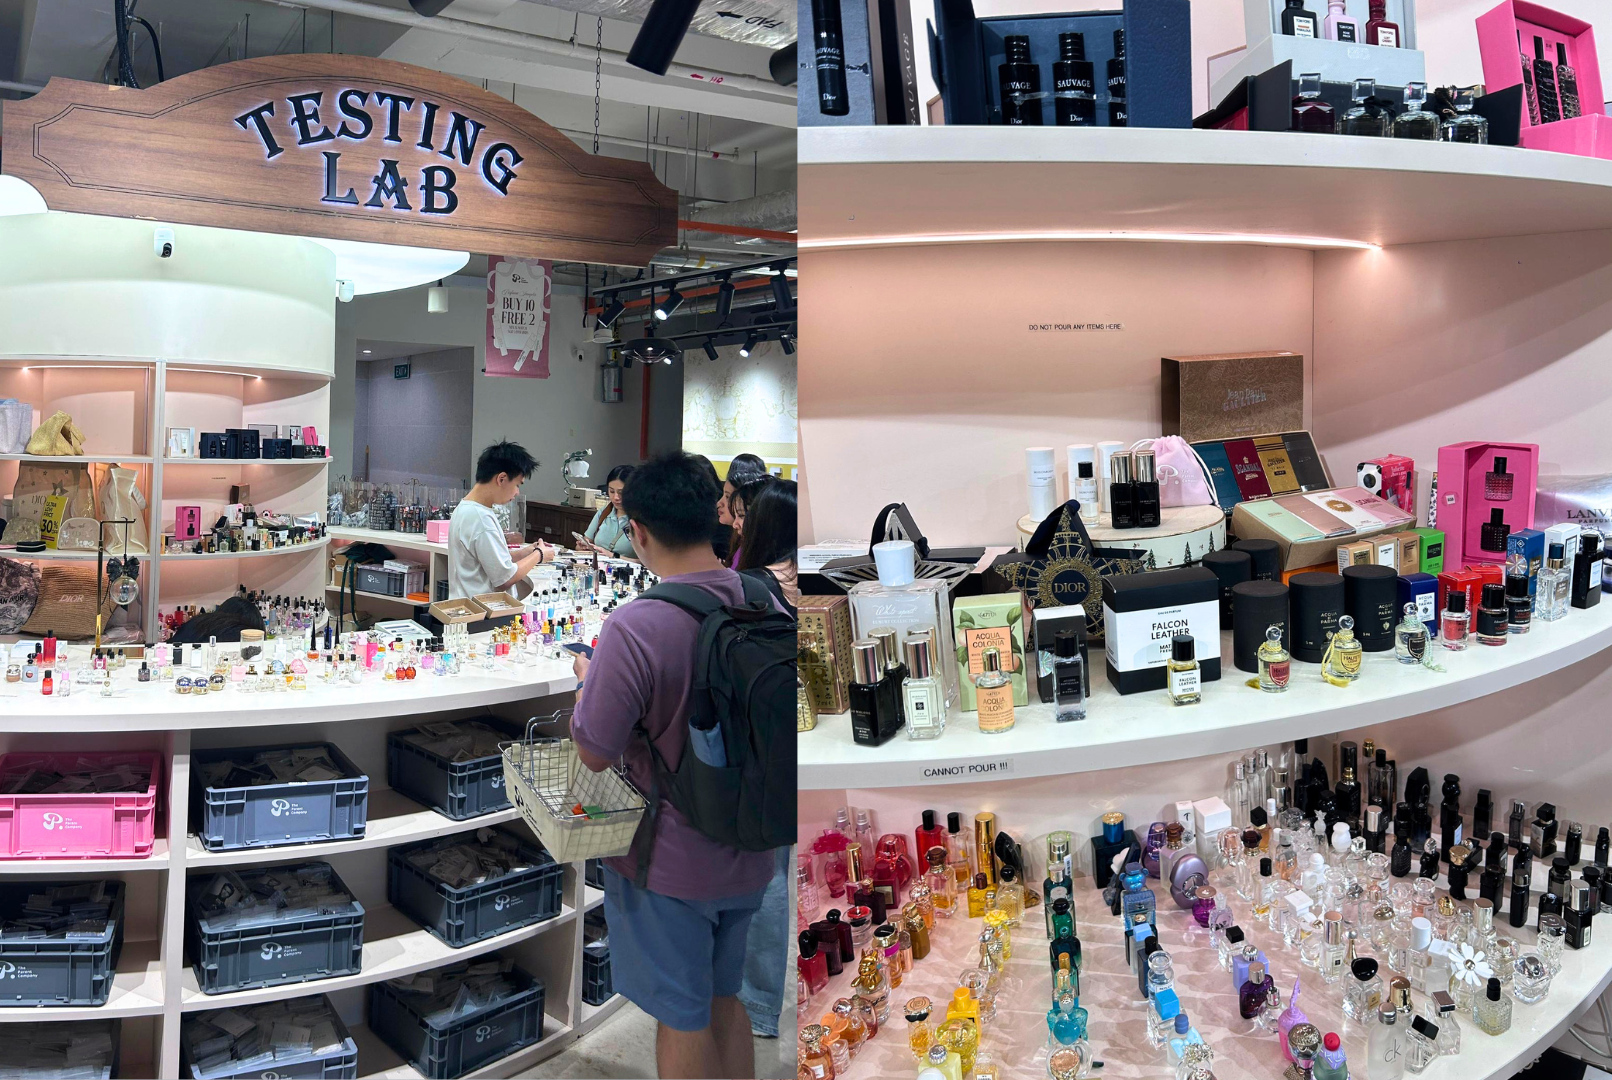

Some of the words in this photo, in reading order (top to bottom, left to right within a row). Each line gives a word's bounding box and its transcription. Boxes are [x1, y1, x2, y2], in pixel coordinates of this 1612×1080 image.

[1057, 79, 1091, 88] SAUVAGE
[1010, 117, 1023, 125] Dior
[1070, 114, 1083, 122] Dior
[1117, 112, 1128, 120] Dio
[234, 88, 525, 196] TESTING
[321, 151, 459, 214] LAB
[502, 297, 520, 311] BUY
[525, 299, 535, 311] 10
[501, 311, 527, 325] FREE
[529, 313, 535, 326] 2
[1227, 388, 1244, 400] Jean
[1245, 387, 1263, 400] Paul
[1223, 392, 1267, 411] GAULTIER
[31, 495, 46, 505] DIO
[1054, 582, 1087, 593] DIOR
[59, 594, 85, 602] DIOR
[1152, 619, 1188, 631] FALCON
[975, 632, 1000, 640] ACQUA
[1151, 628, 1190, 640] LEATHER
[972, 639, 1005, 648] COLONIA
[982, 696, 1006, 705] ACQUA
[923, 765, 965, 777] CANNOT
[968, 763, 997, 773] POUR
[999, 761, 1008, 770] !!!
[1384, 1038, 1402, 1063] ck
